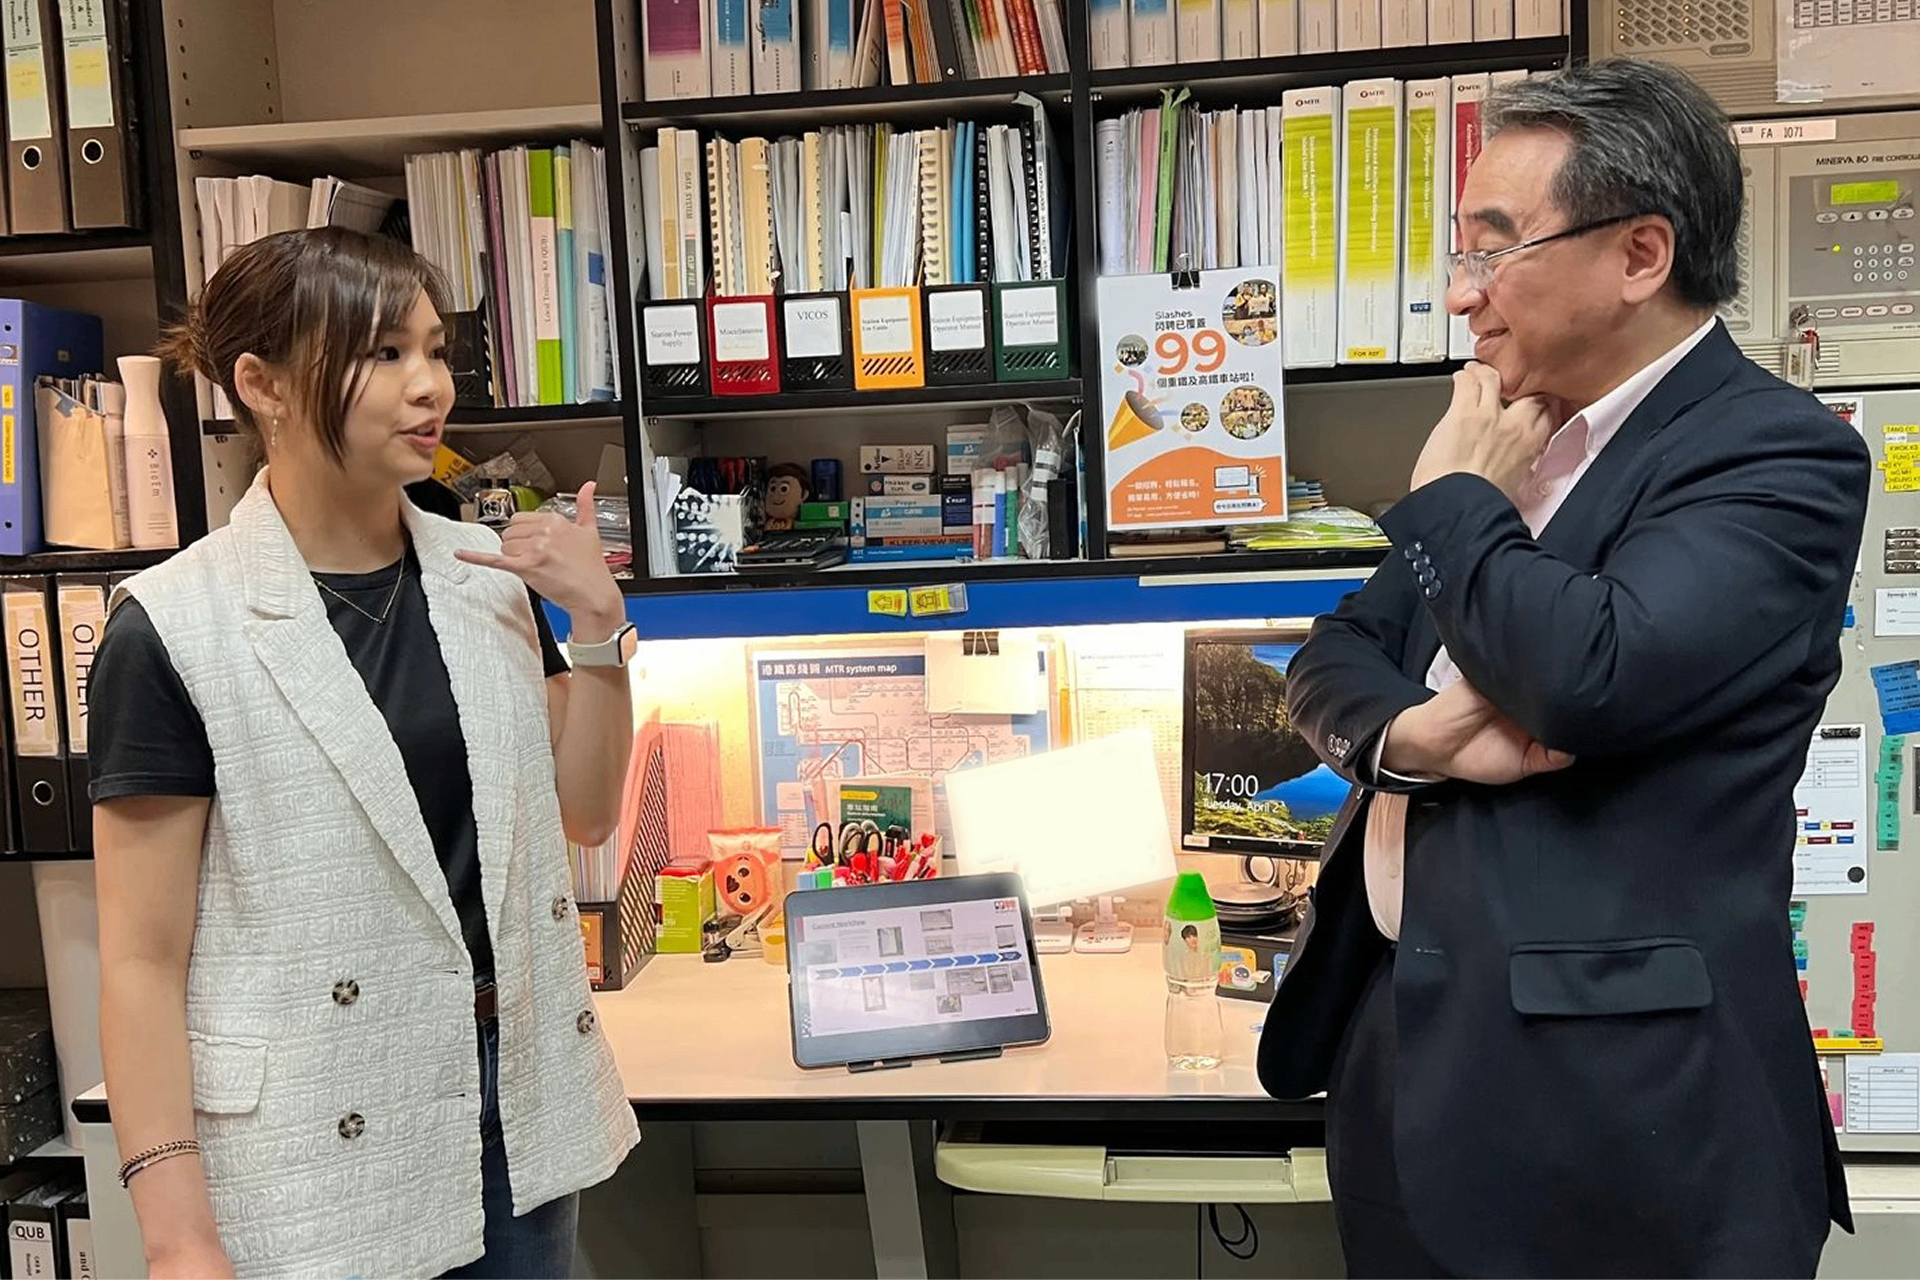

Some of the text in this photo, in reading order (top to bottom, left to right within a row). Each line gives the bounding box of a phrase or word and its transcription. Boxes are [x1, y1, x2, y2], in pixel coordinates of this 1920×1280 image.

[1761, 128, 1773, 139] FA
[1784, 126, 1803, 139] 1071
[1816, 157, 1854, 166] MINERVA
[797, 310, 829, 320] VICOS
[1155, 311, 1193, 320] Slashes
[1154, 329, 1226, 375] 99
[914, 449, 924, 470] INK
[18, 629, 46, 721] OTHER
[825, 664, 844, 674] MTR
[845, 664, 876, 675] system
[877, 663, 897, 675] map
[1203, 772, 1259, 797] 17:00
[1247, 801, 1270, 812] April
[1272, 804, 1278, 813] 2
[15, 1226, 45, 1239] QUB
